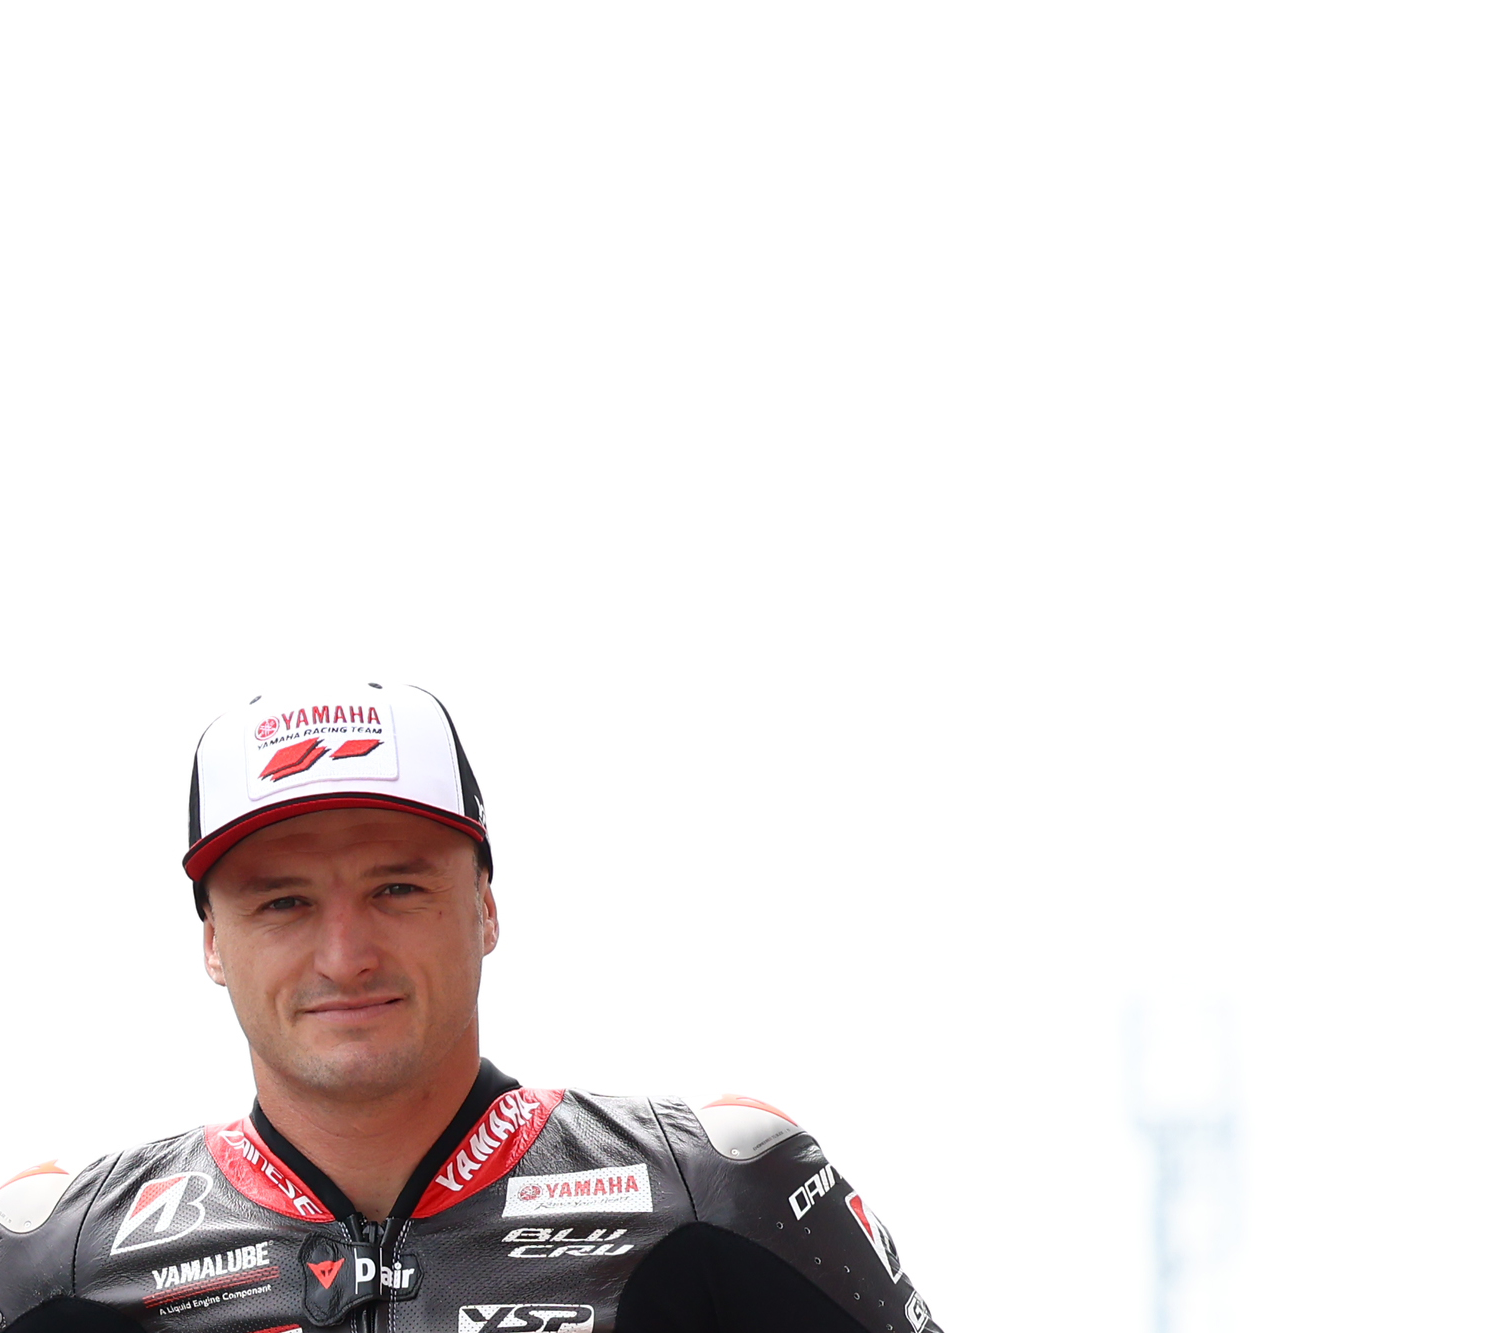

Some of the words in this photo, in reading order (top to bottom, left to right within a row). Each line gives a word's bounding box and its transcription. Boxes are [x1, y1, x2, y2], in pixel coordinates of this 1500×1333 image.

[281, 705, 382, 732] YAMAHA
[257, 731, 301, 750] YAMAHA
[303, 725, 348, 738] RACING
[350, 725, 383, 736] TEAM
[435, 1088, 542, 1194] YAMAHA
[544, 1174, 640, 1200] YAMAHA
[507, 1243, 635, 1259] CRU
[151, 1242, 271, 1291] YAMALUBE
[167, 1300, 192, 1315] Liquid
[192, 1294, 220, 1310] Engine
[221, 1284, 272, 1303] Component
